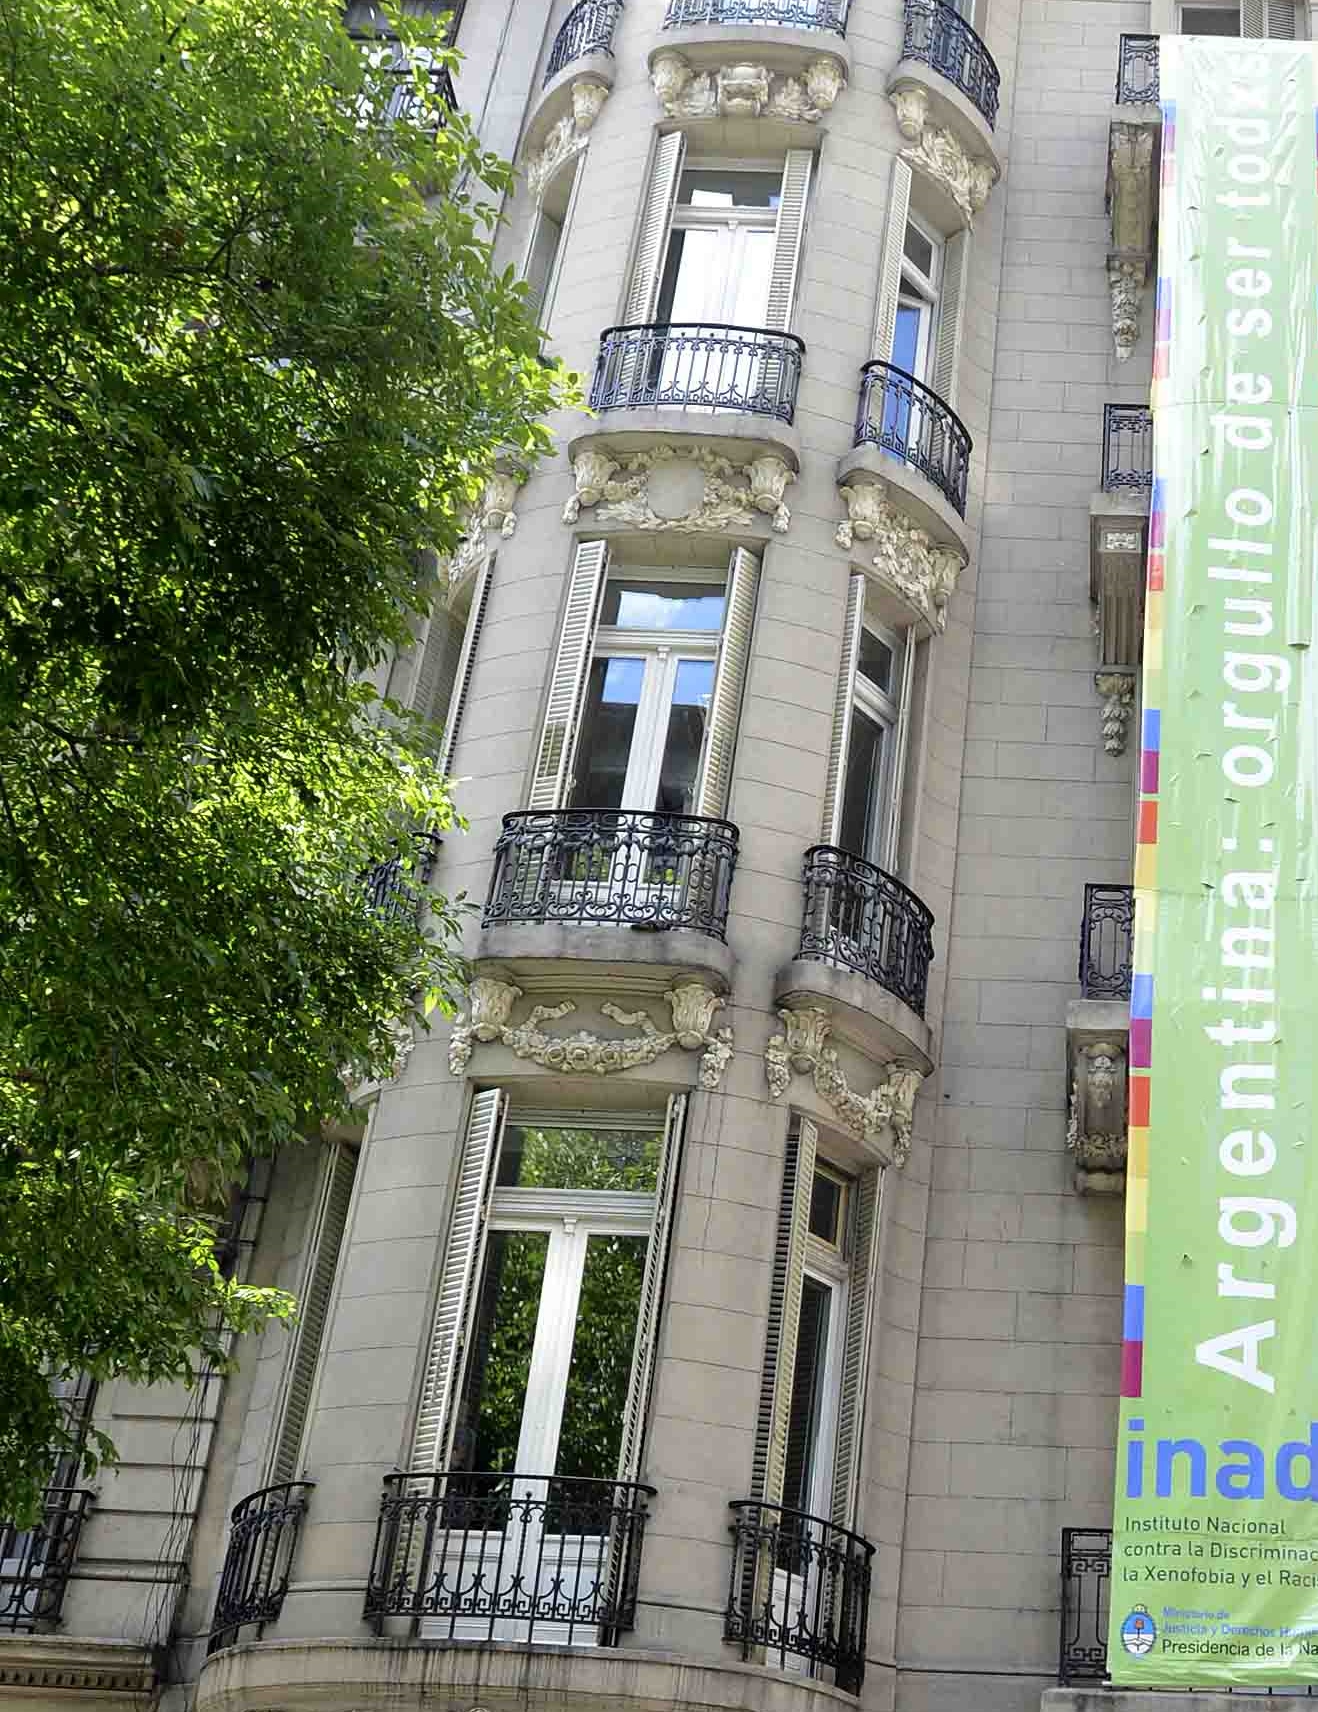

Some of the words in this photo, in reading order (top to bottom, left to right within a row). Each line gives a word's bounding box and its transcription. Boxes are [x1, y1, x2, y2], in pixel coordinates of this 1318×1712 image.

[1226, 237, 1272, 338] ser
[1210, 372, 1272, 450] de
[1208, 488, 1291, 788] orgullo
[1196, 837, 1297, 1393] Argentina:
[1124, 1541, 1181, 1557] contra
[1188, 1541, 1204, 1558] la
[1125, 1516, 1200, 1532] Instituto
[1207, 1517, 1286, 1535] Nacional
[1123, 1567, 1139, 1582] la
[1144, 1566, 1235, 1585] Xenofobia
[1241, 1572, 1251, 1588] y
[1256, 1571, 1273, 1586] el
[1162, 1639, 1250, 1656] Presidencia
[1255, 1644, 1274, 1657] de
